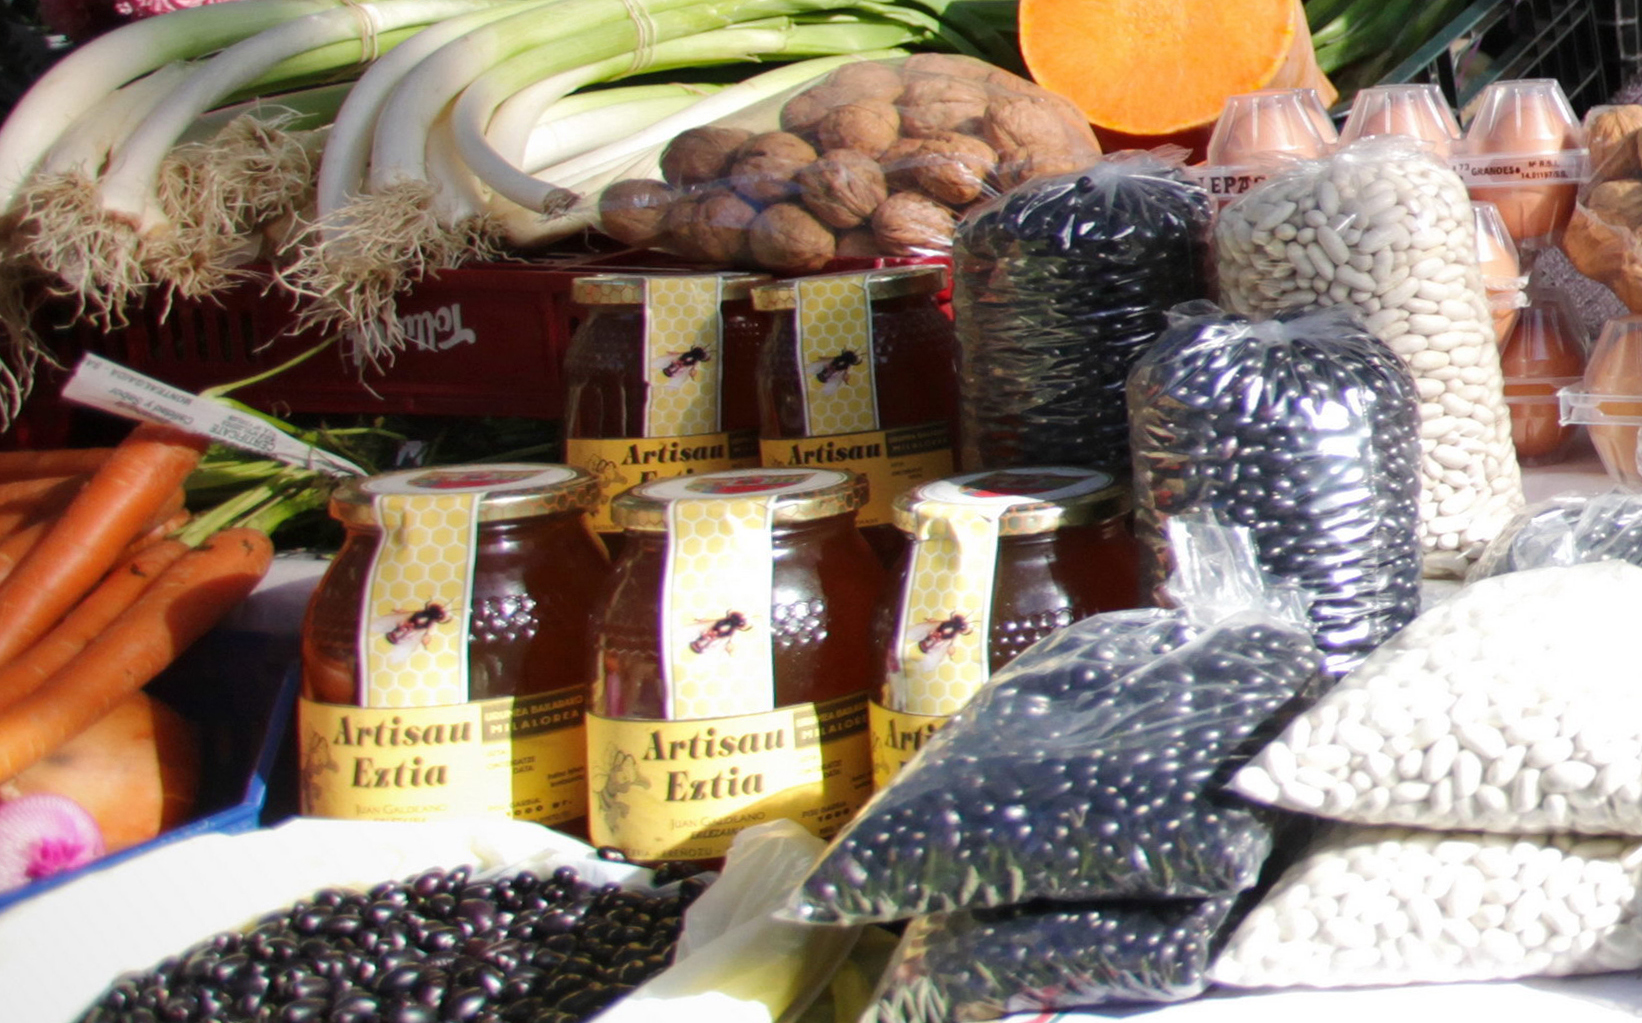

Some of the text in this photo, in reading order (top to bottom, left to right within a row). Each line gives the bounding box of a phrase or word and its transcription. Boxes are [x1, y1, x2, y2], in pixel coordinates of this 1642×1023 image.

[1471, 165, 1515, 177] GRANDES
[621, 440, 726, 466] Artisau
[788, 440, 883, 466] Artisau
[333, 714, 472, 747] Artisau
[643, 728, 786, 761] Artisau
[350, 755, 449, 789] Eztia
[665, 766, 765, 802] Eztia
